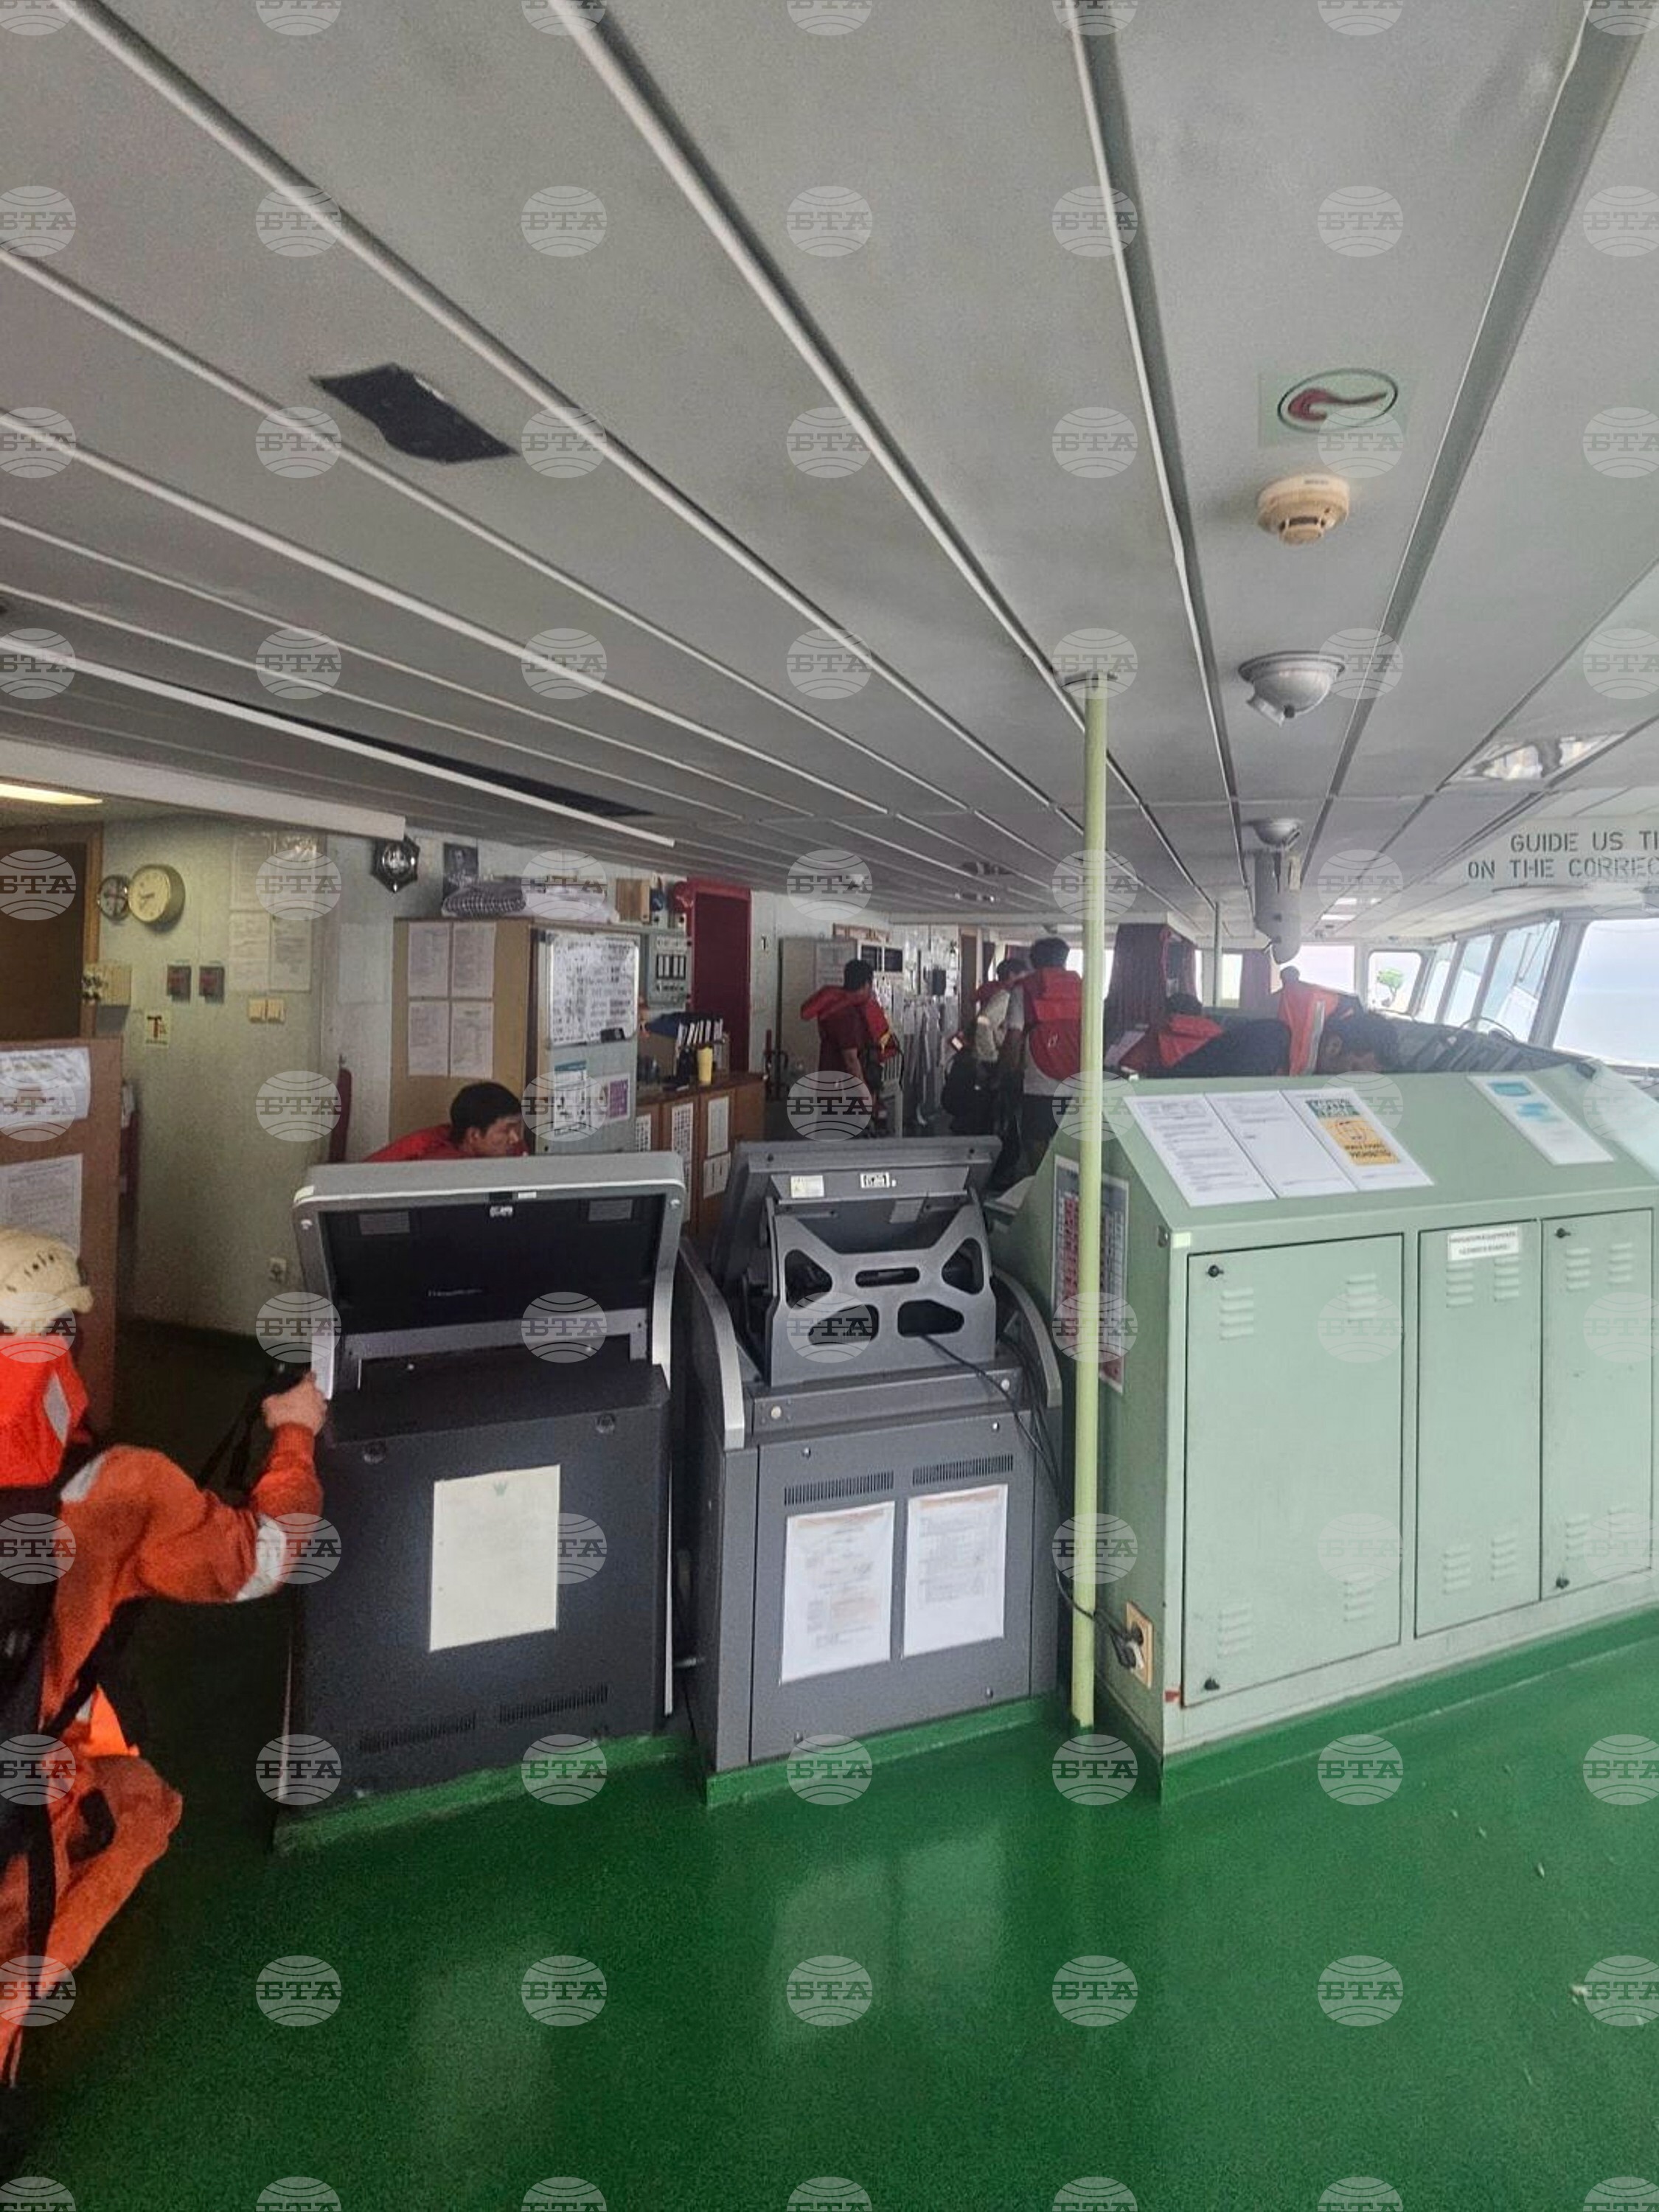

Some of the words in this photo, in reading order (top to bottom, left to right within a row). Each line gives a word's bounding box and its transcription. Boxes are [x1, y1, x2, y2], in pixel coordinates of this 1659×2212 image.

[1511, 832, 1578, 852] GUIDE
[1593, 831, 1623, 851] US
[1639, 830, 1659, 850] T
[1469, 860, 1495, 879] ON
[1509, 858, 1554, 878] THE
